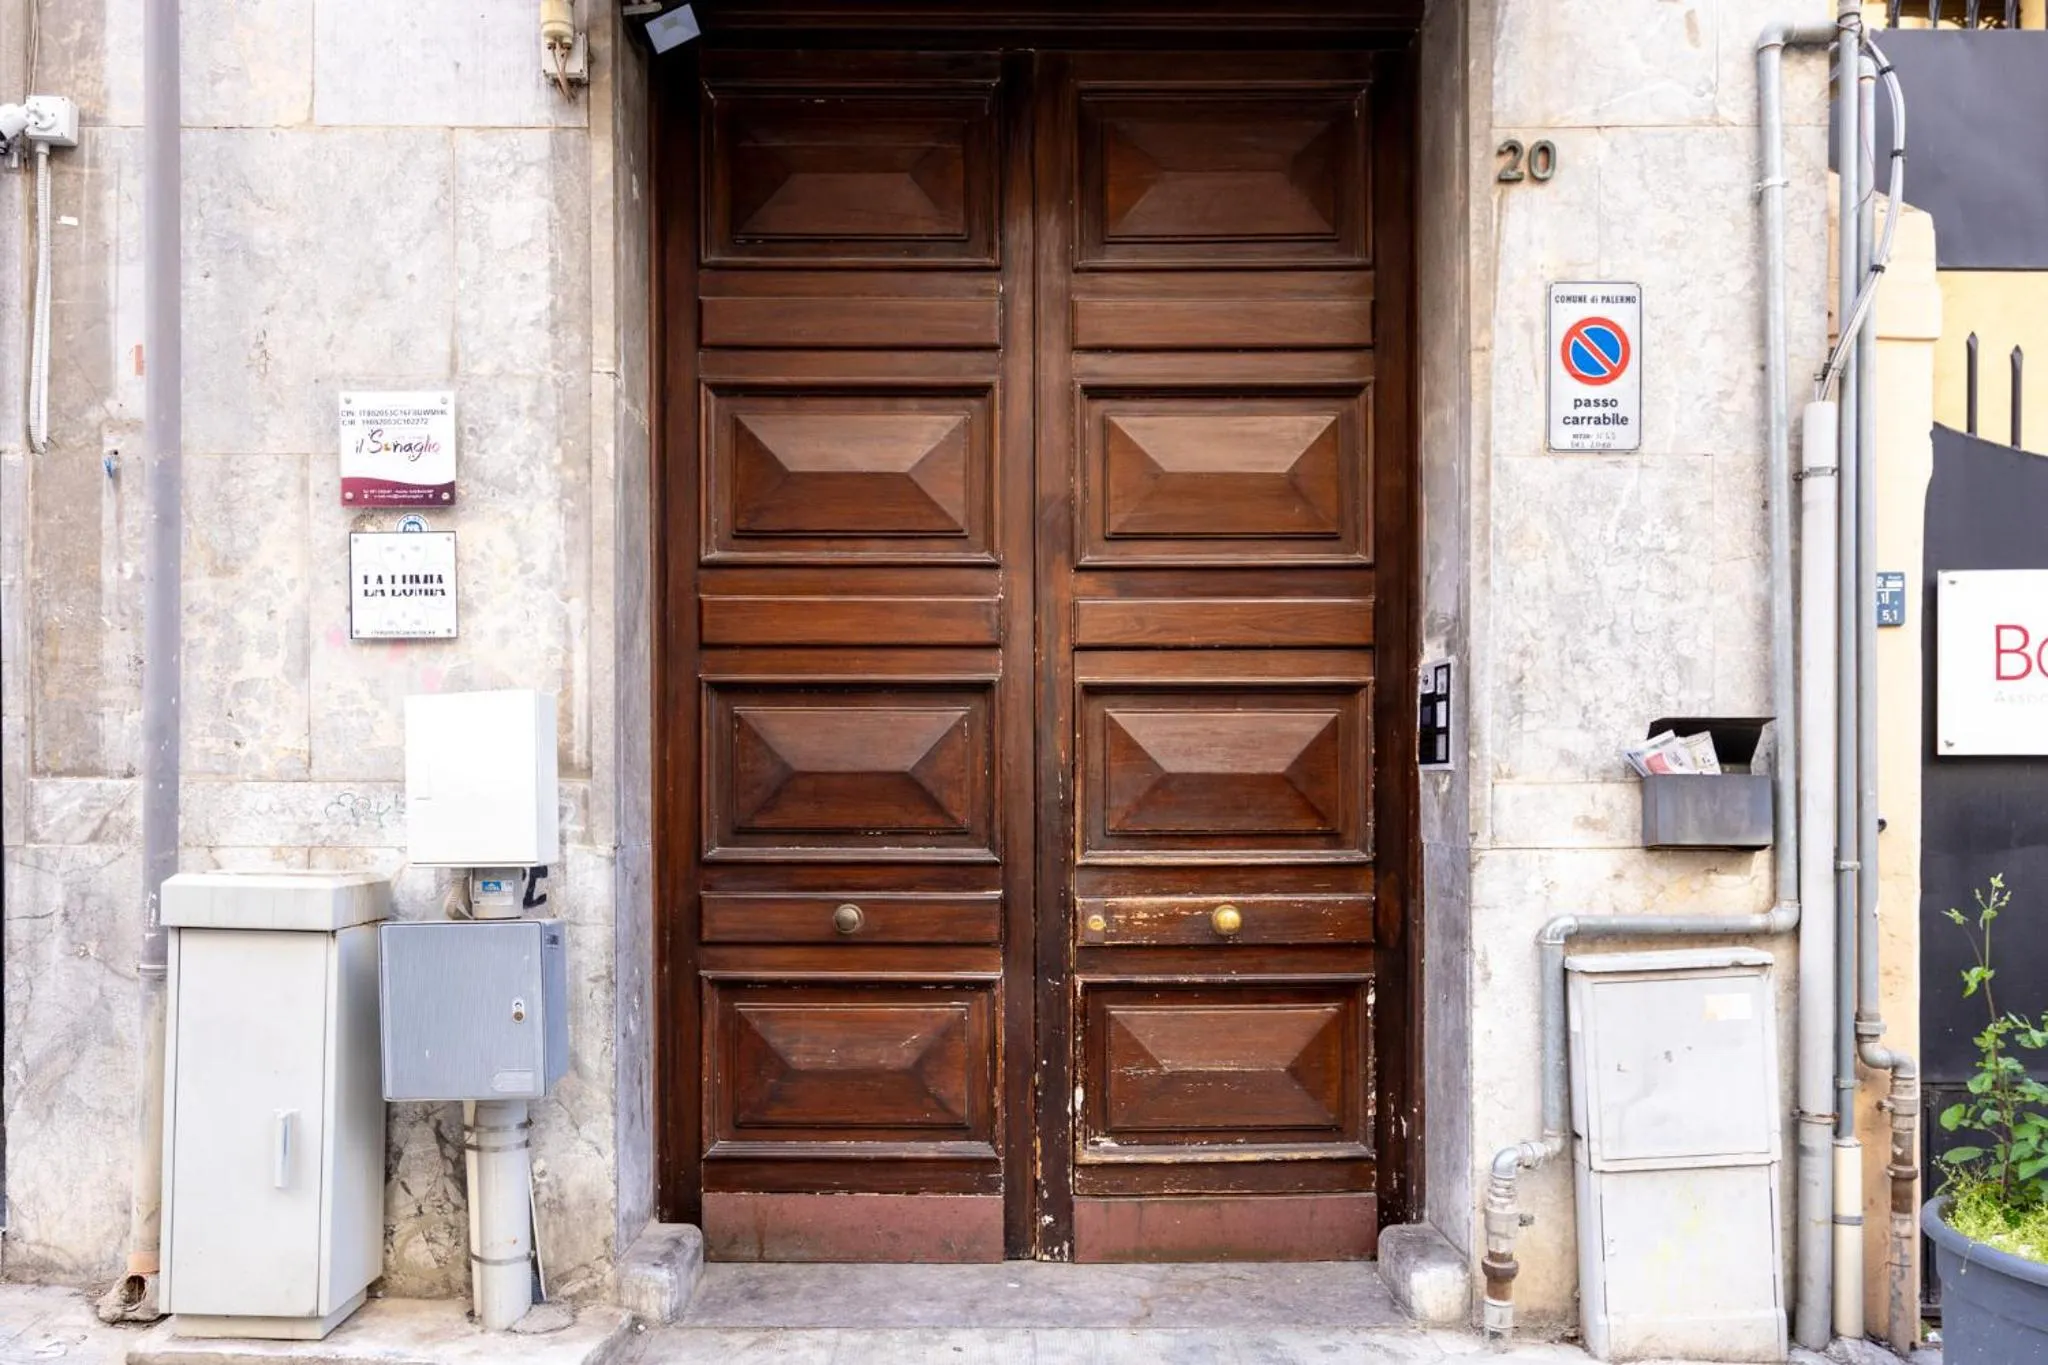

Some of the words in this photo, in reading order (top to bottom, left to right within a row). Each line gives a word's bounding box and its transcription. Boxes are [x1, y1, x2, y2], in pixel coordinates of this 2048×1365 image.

[1496, 140, 1557, 182] 20
[1554, 295, 1587, 304] COMUNE
[1590, 295, 1598, 304] di
[1601, 295, 1637, 304] PALERMO
[1573, 398, 1619, 409] passo
[1562, 413, 1629, 426] carrabile
[355, 439, 364, 453] il
